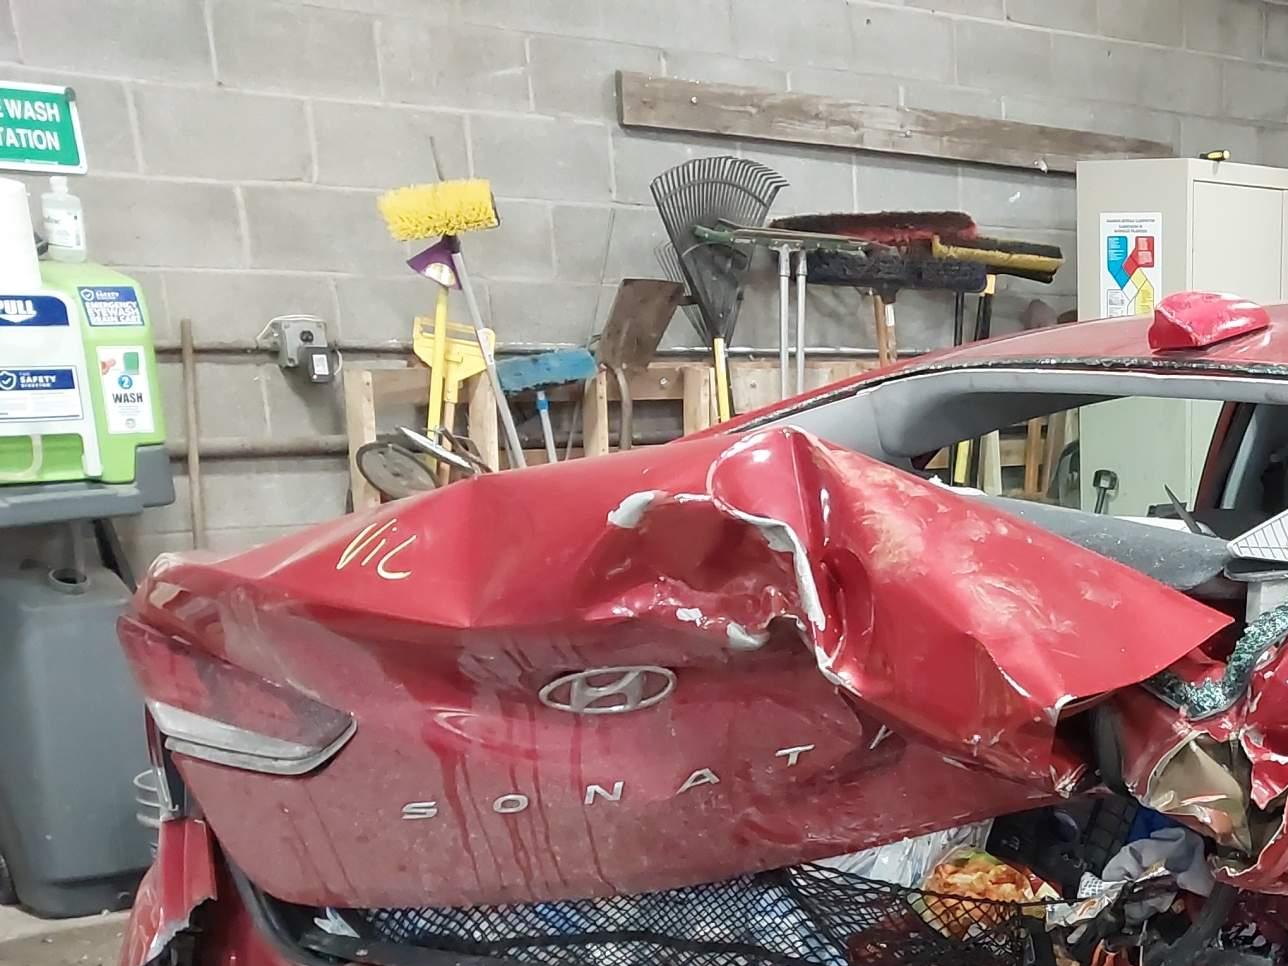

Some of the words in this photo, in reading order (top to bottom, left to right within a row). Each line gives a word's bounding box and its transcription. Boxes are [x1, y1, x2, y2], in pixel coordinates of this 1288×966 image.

[4, 98, 61, 122] WASH
[20, 375, 56, 383] SAFETY
[112, 392, 143, 404] WASH
